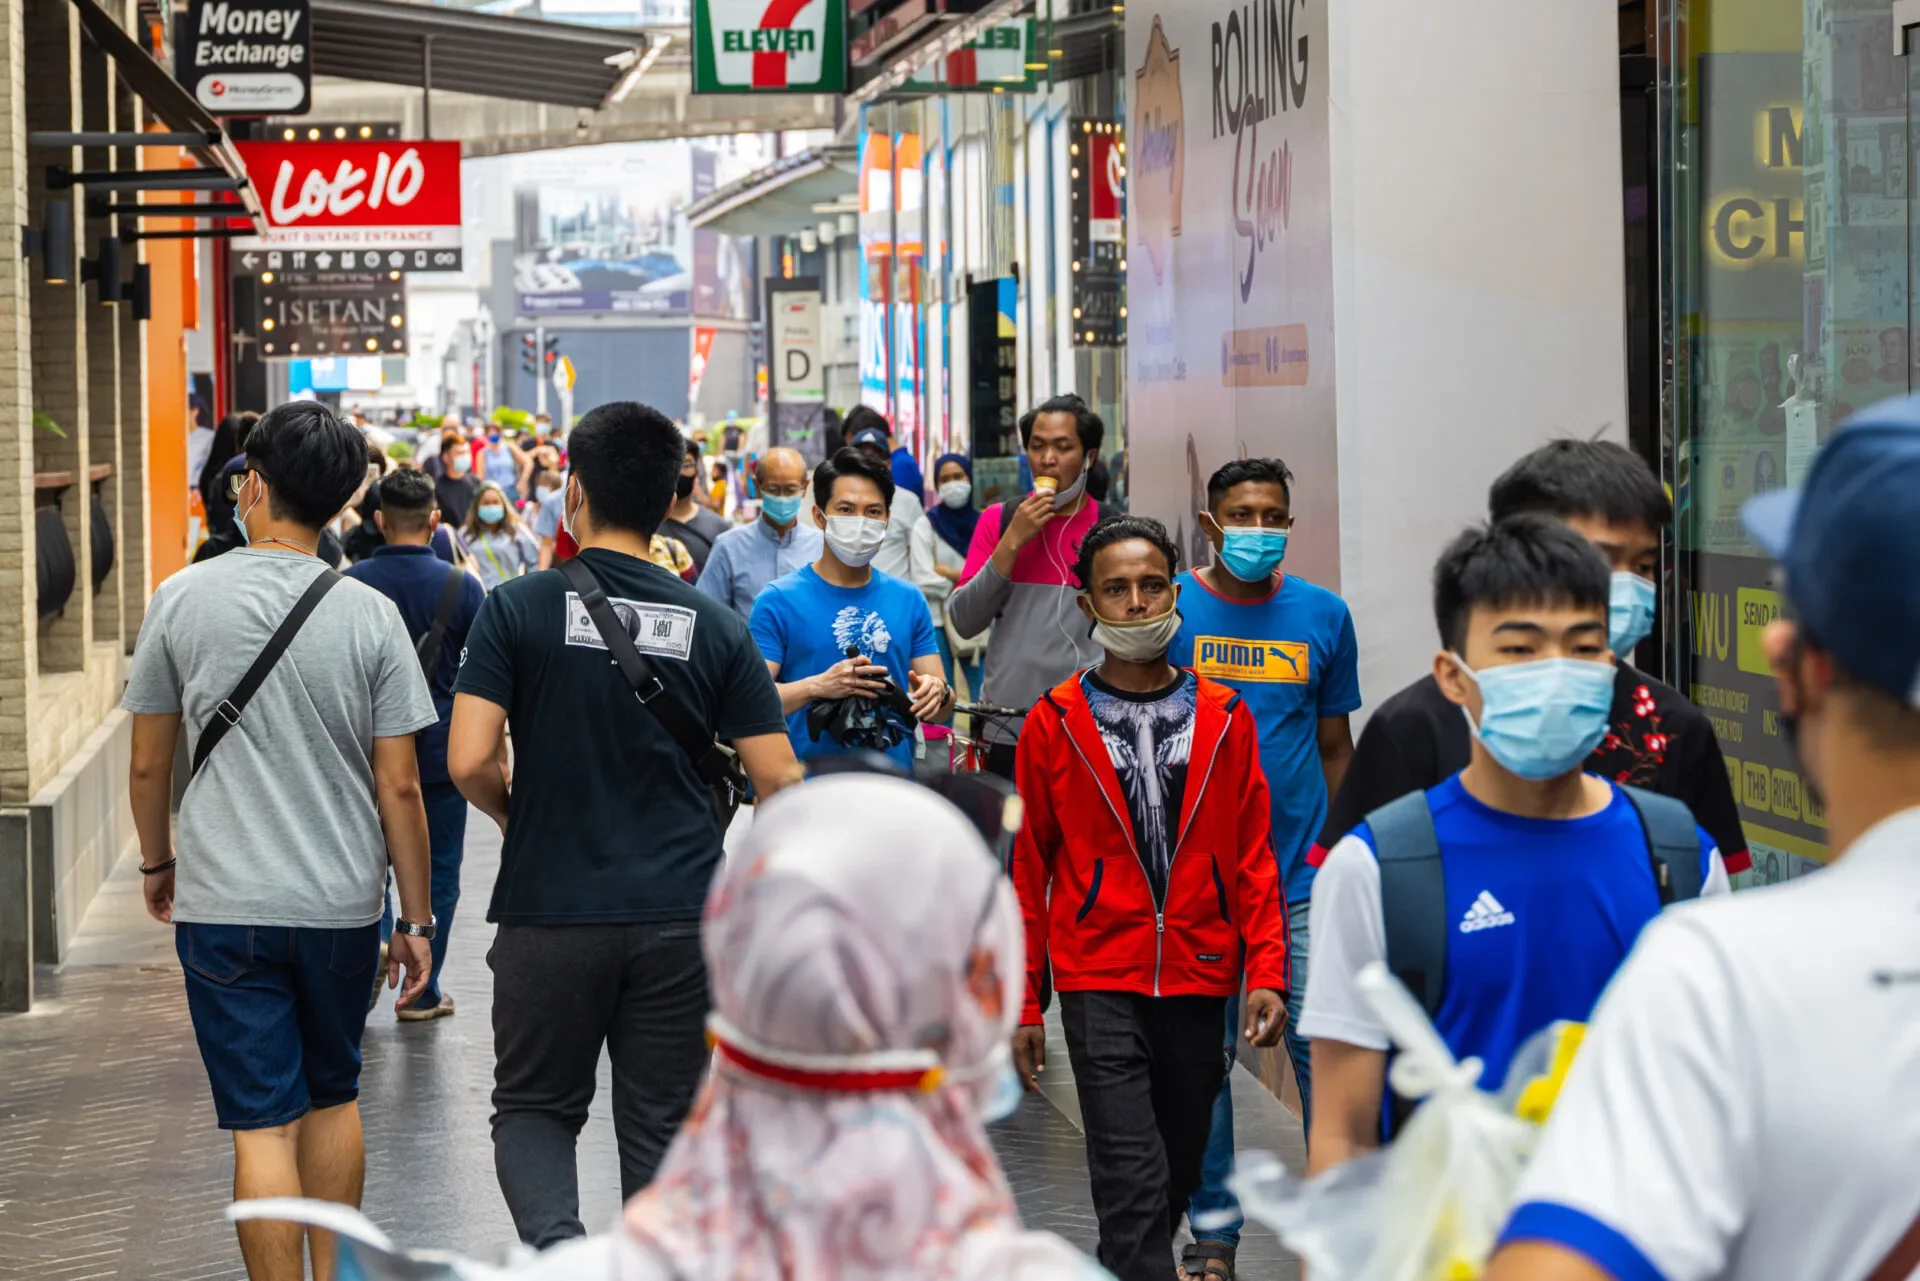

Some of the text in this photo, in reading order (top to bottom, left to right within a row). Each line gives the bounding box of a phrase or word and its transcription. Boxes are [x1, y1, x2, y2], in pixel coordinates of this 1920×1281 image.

[199, 2, 301, 40] Money
[195, 40, 304, 69] Exchange
[1212, 0, 1309, 139] ROLLING
[364, 230, 433, 243] ENTRANCE
[279, 298, 386, 326] ISETAN
[786, 350, 811, 382] D
[1744, 601, 1770, 626] SEND
[1201, 642, 1265, 667] PUMA
[1708, 686, 1726, 709] YOUR
[1726, 688, 1750, 714] MONEY
[1729, 719, 1743, 743] YOU
[1747, 769, 1767, 802] THB
[1773, 775, 1799, 812] RIYAL
[1459, 911, 1516, 934] adidas
